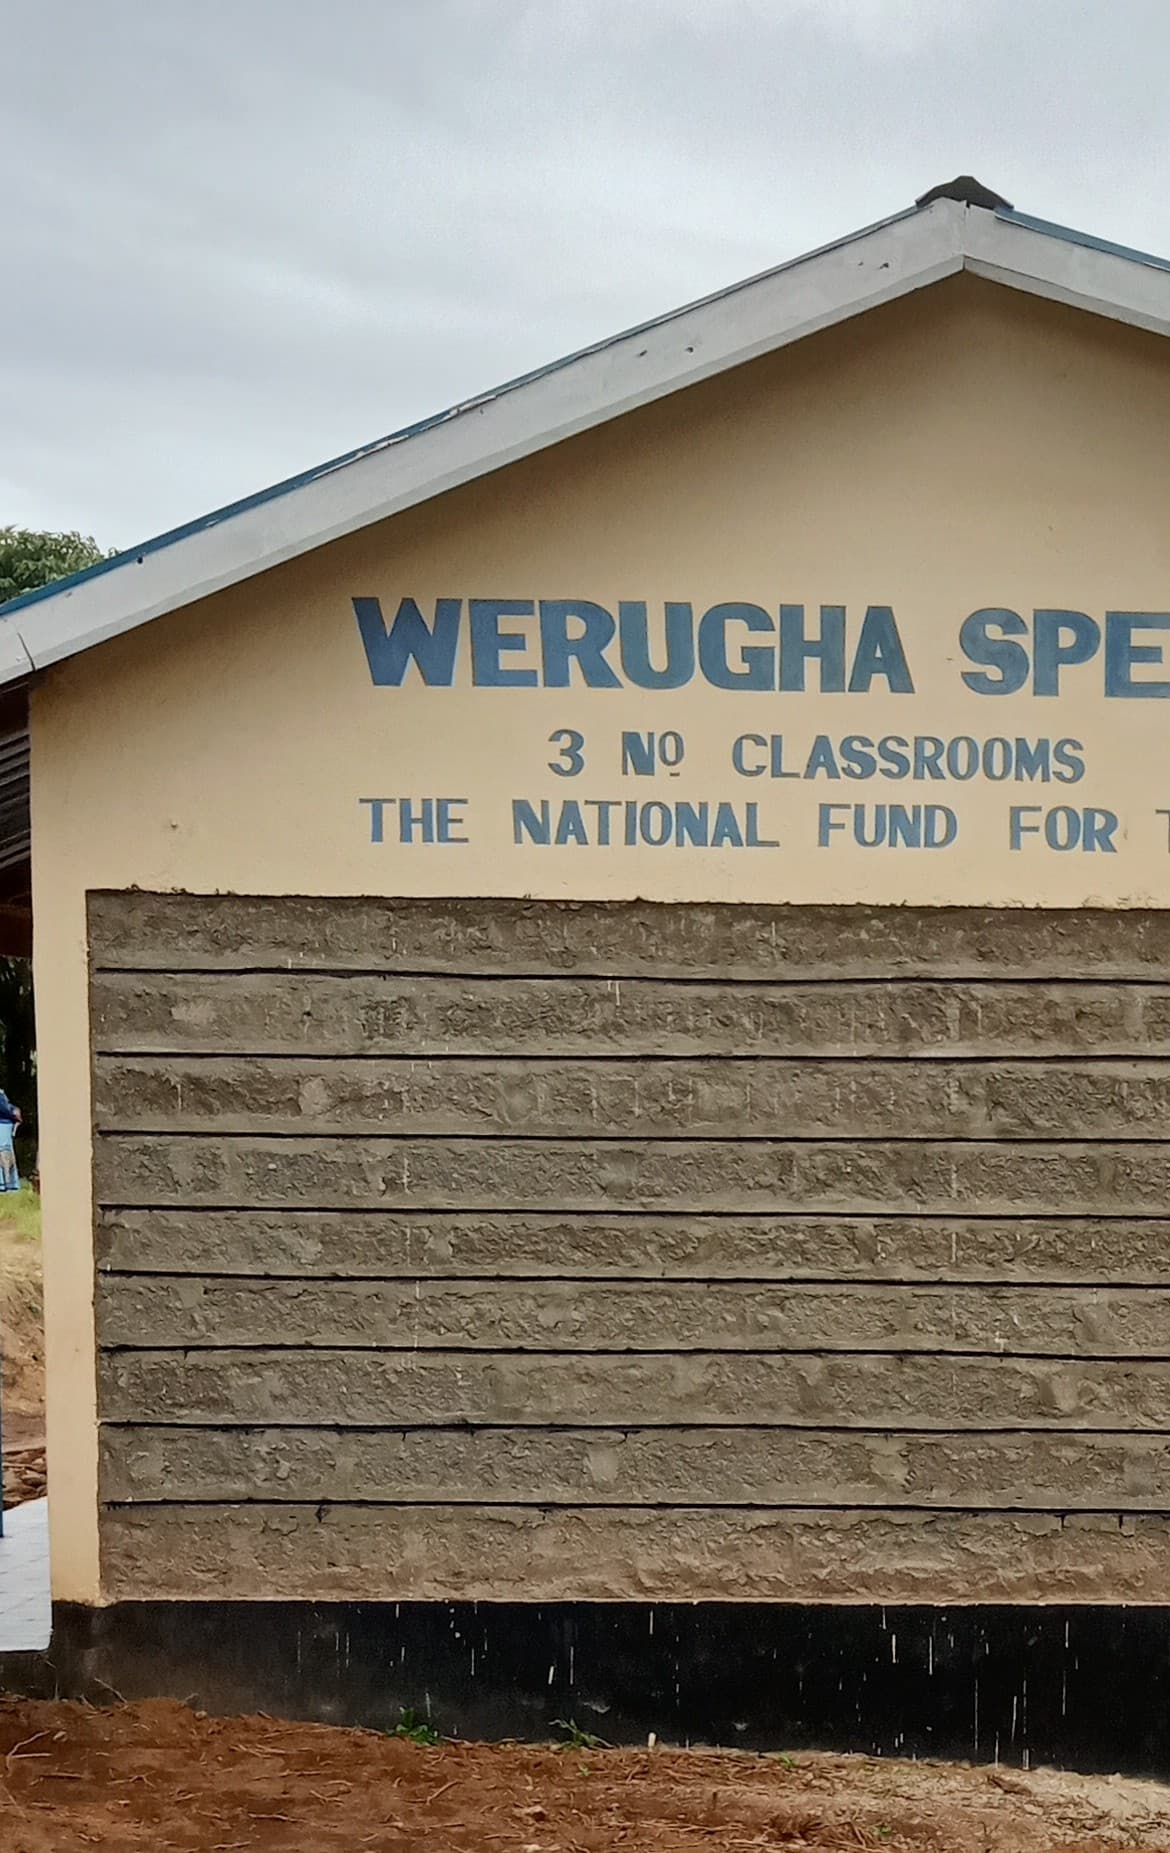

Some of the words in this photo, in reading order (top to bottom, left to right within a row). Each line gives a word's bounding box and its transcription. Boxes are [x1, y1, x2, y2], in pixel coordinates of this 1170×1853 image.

[353, 597, 915, 695] WERUGHA
[548, 729, 587, 778] 3
[733, 734, 1086, 784] CLASSROOMS
[359, 798, 469, 845] THE
[512, 798, 780, 849] NATIONAL
[817, 803, 959, 850] FUND
[1009, 806, 1119, 854] FOR
